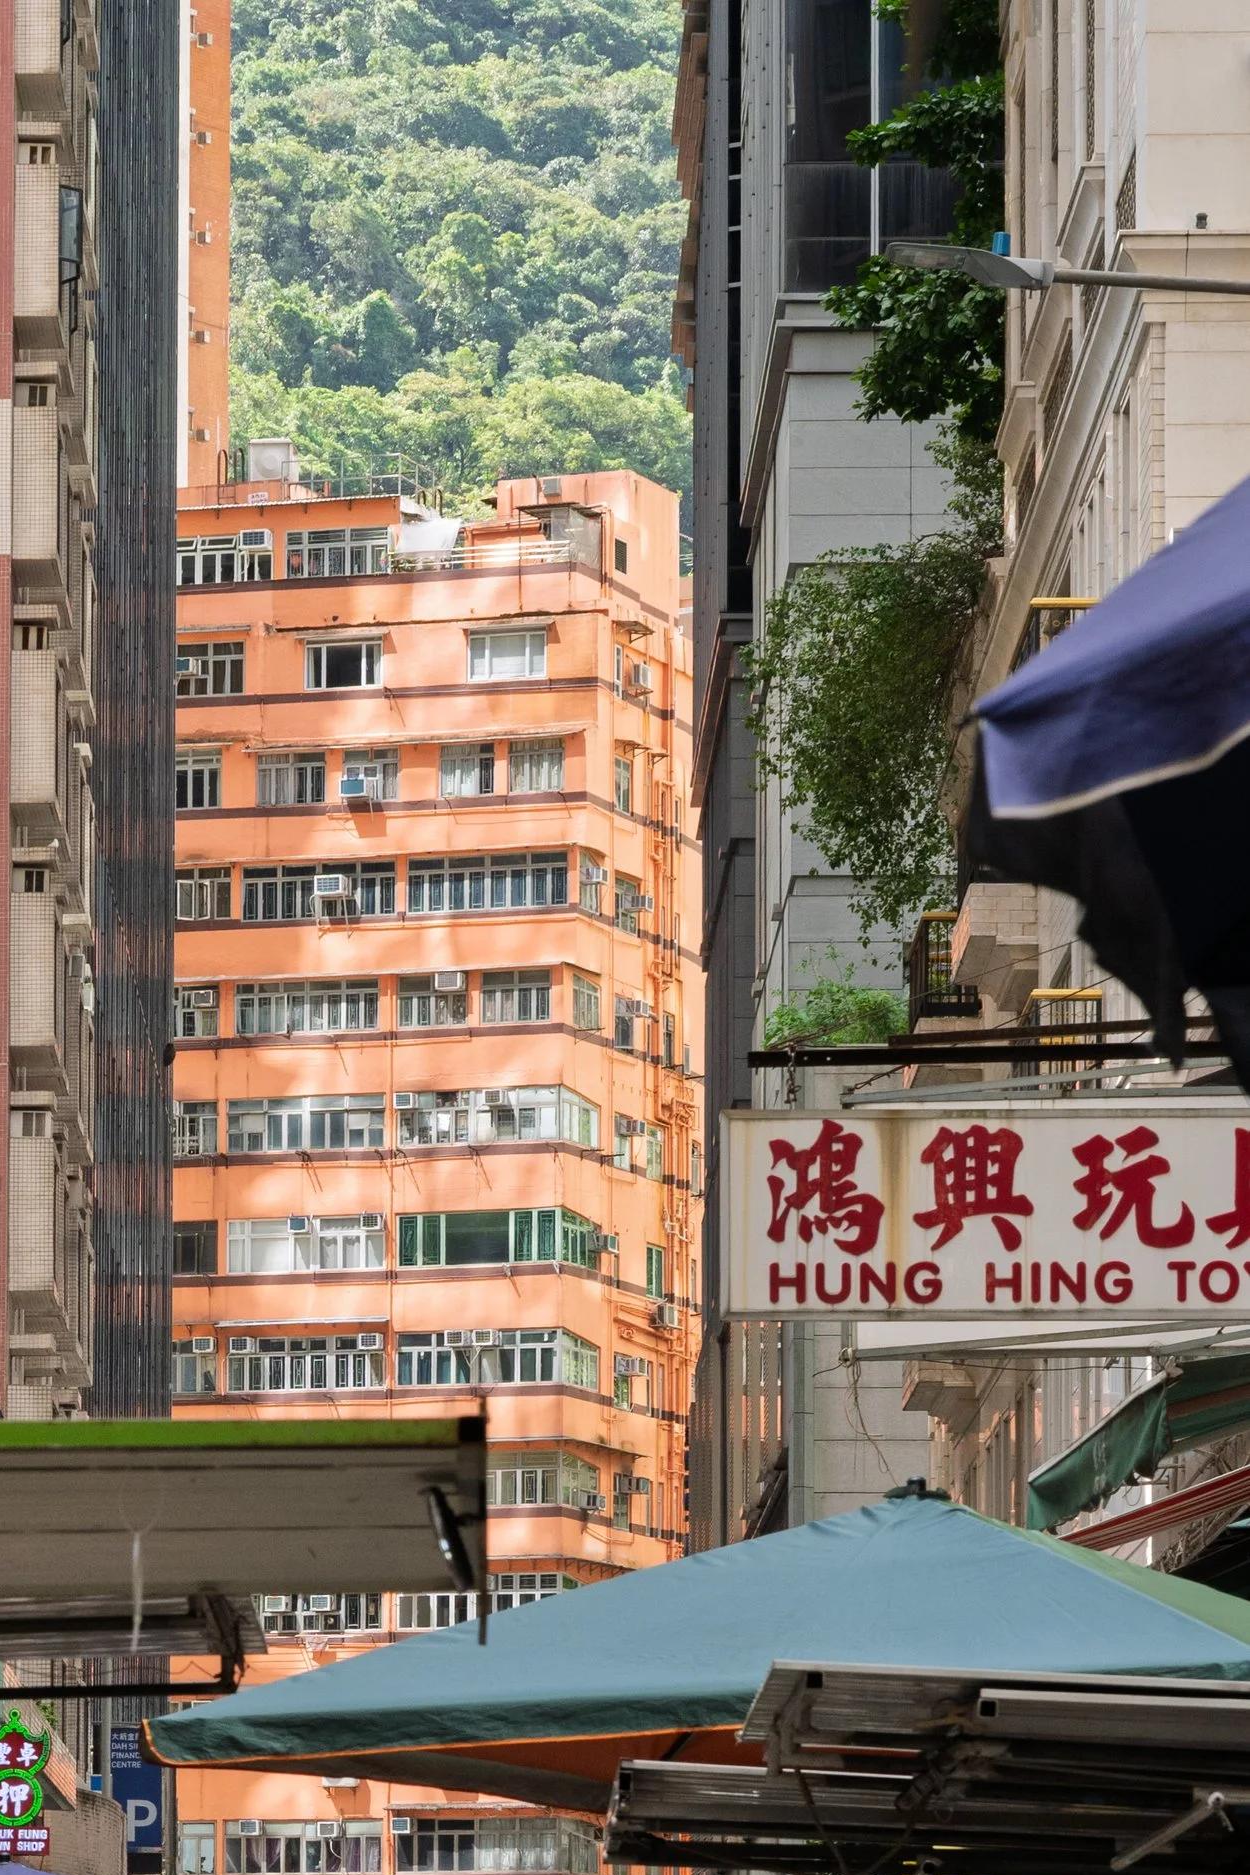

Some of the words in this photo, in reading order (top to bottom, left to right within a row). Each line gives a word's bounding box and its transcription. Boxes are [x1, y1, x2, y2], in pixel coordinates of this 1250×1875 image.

[769, 1261, 943, 1304] HUNG
[985, 1261, 1133, 1304] HING
[1167, 1261, 1250, 1304] TO
[111, 1742, 128, 1750] DAH
[127, 1799, 157, 1842] P
[18, 1829, 48, 1840] FUNG
[17, 1841, 45, 1851] SHOP
